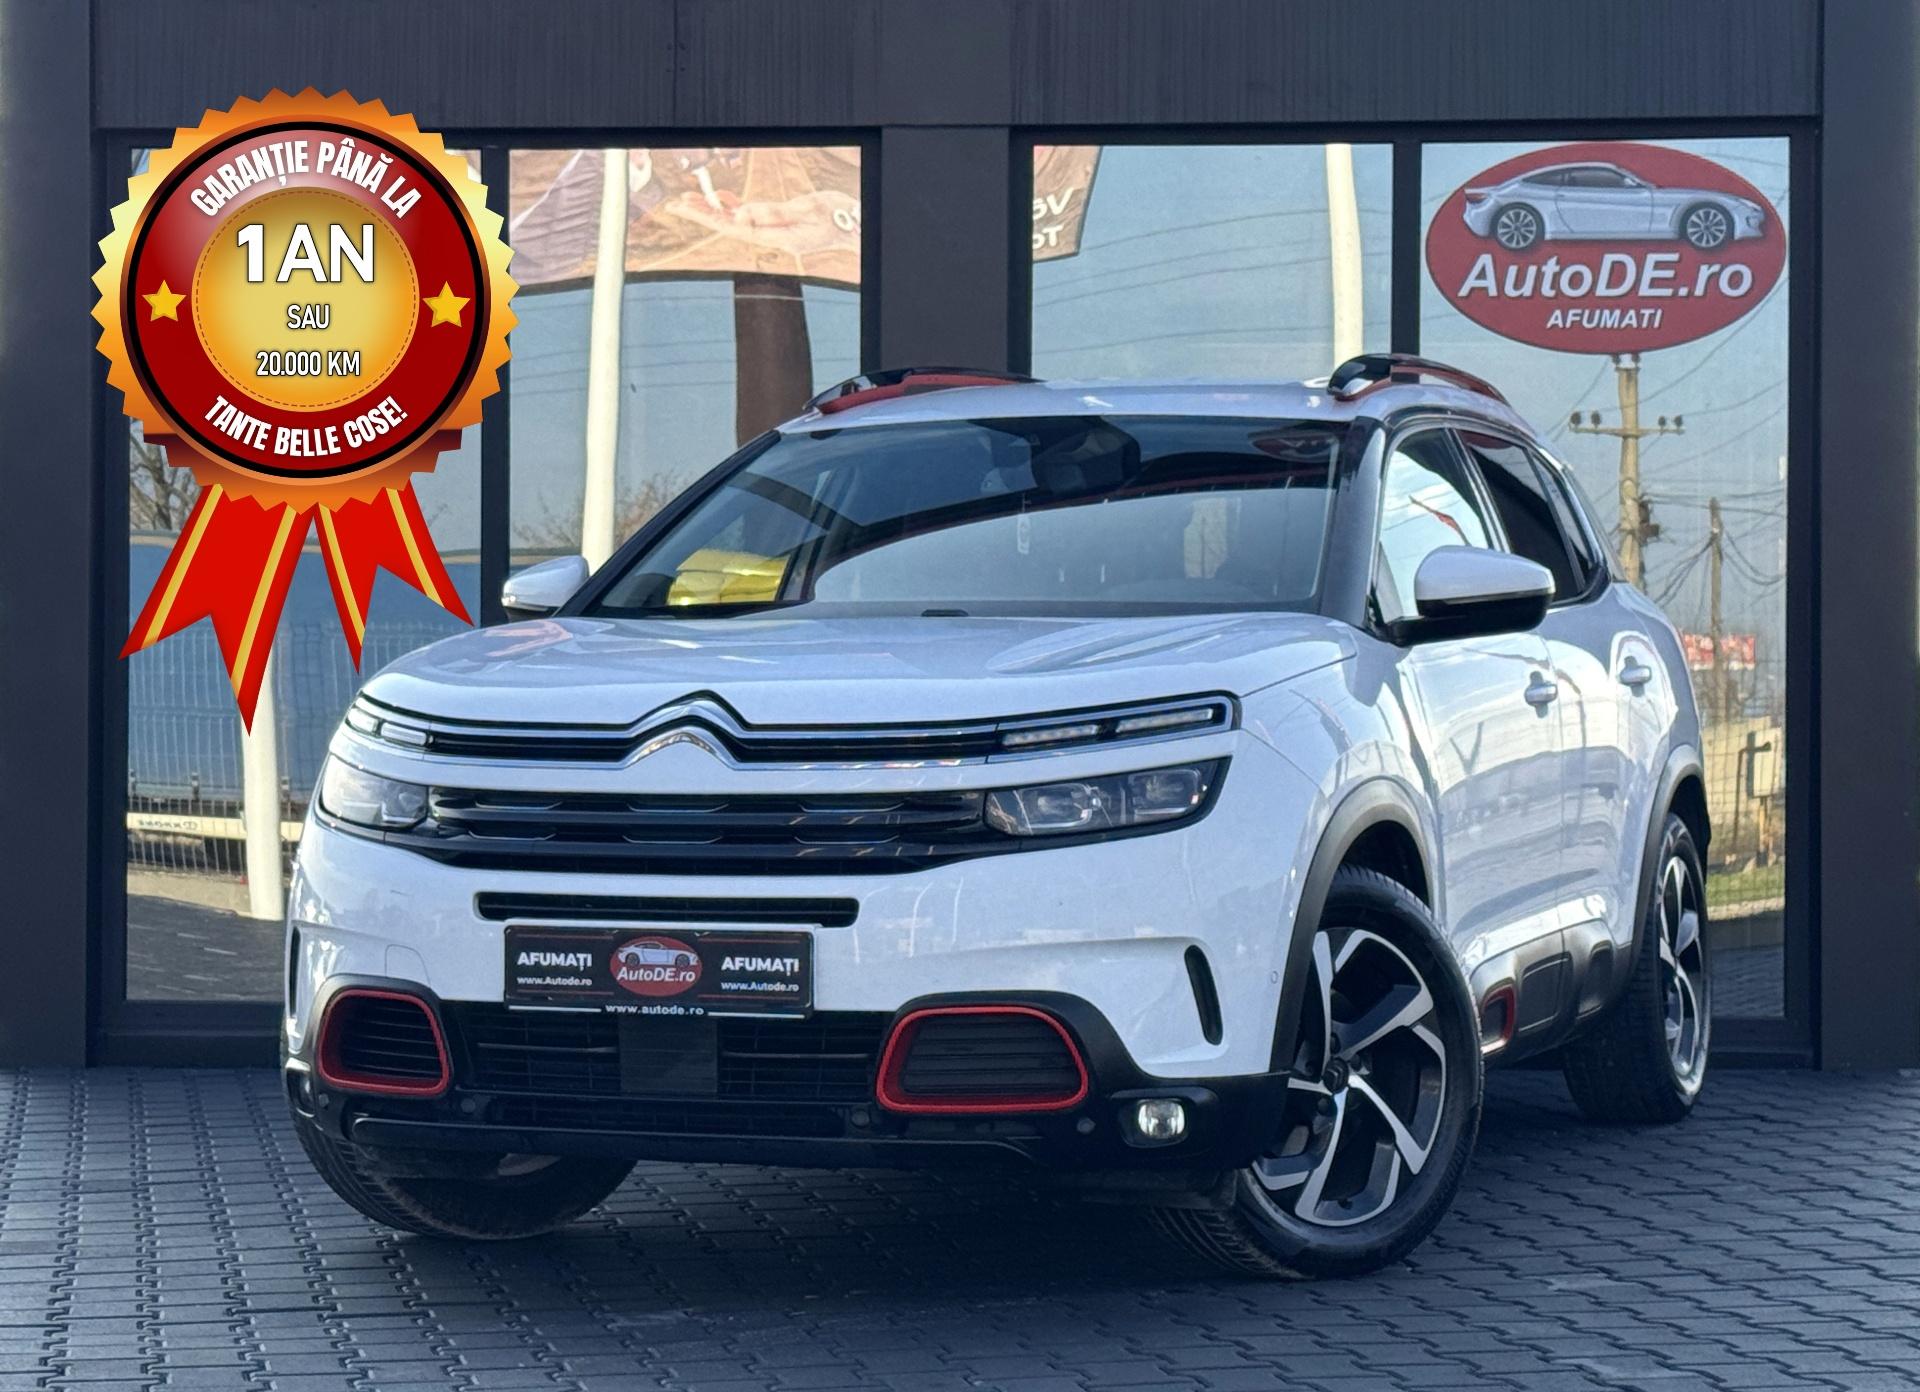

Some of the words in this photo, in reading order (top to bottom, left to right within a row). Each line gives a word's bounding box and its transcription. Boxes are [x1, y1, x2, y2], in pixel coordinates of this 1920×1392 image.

[1458, 252, 1753, 298] AutoDE.ro
[1546, 308, 1662, 329] AFUMATI
[517, 951, 593, 970] AFUMAȚI
[721, 956, 800, 976] AFUMAȚI
[517, 976, 593, 986] www.Autode.ro
[616, 966, 696, 983] AutoDE.ro
[721, 981, 800, 992] www.Autode.ro
[605, 1003, 705, 1016] www.autode.ro
